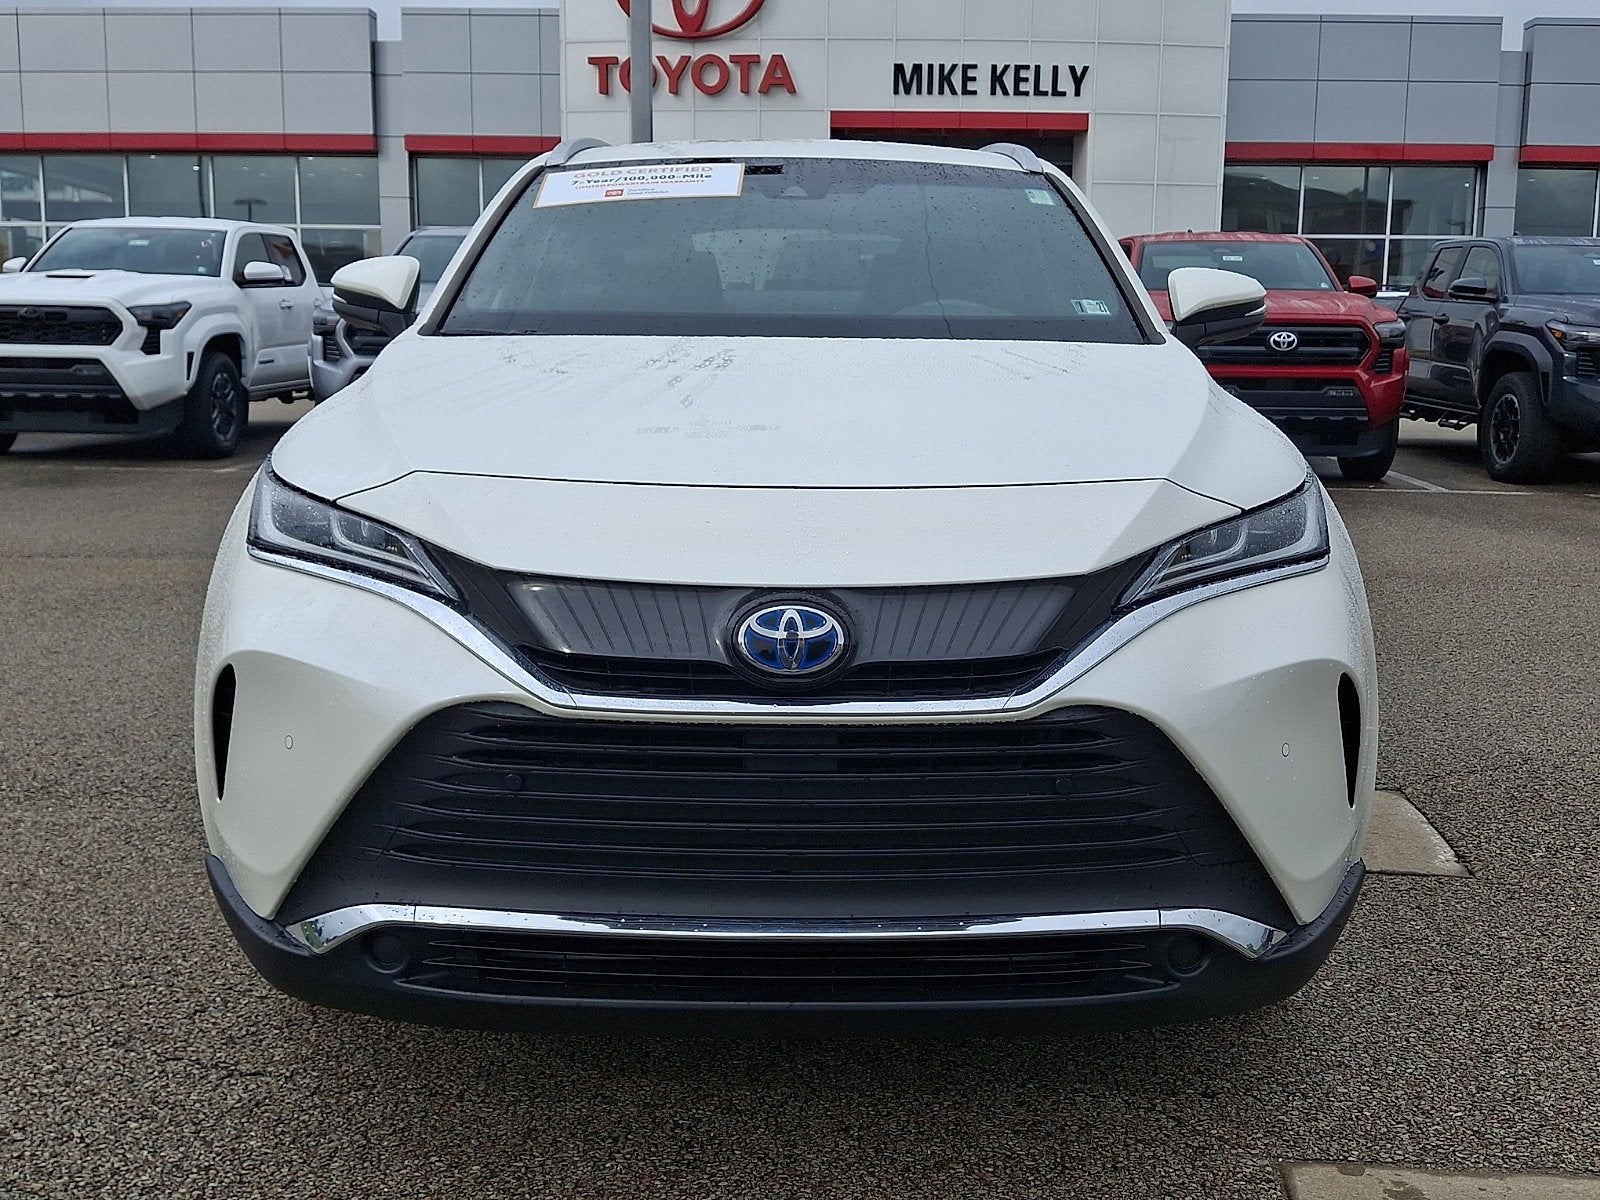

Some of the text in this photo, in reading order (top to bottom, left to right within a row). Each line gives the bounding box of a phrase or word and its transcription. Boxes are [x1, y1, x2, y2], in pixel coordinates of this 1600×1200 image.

[893, 62, 1090, 97] MIKE KELLY
[574, 166, 713, 178] GOLD CERTIFIED
